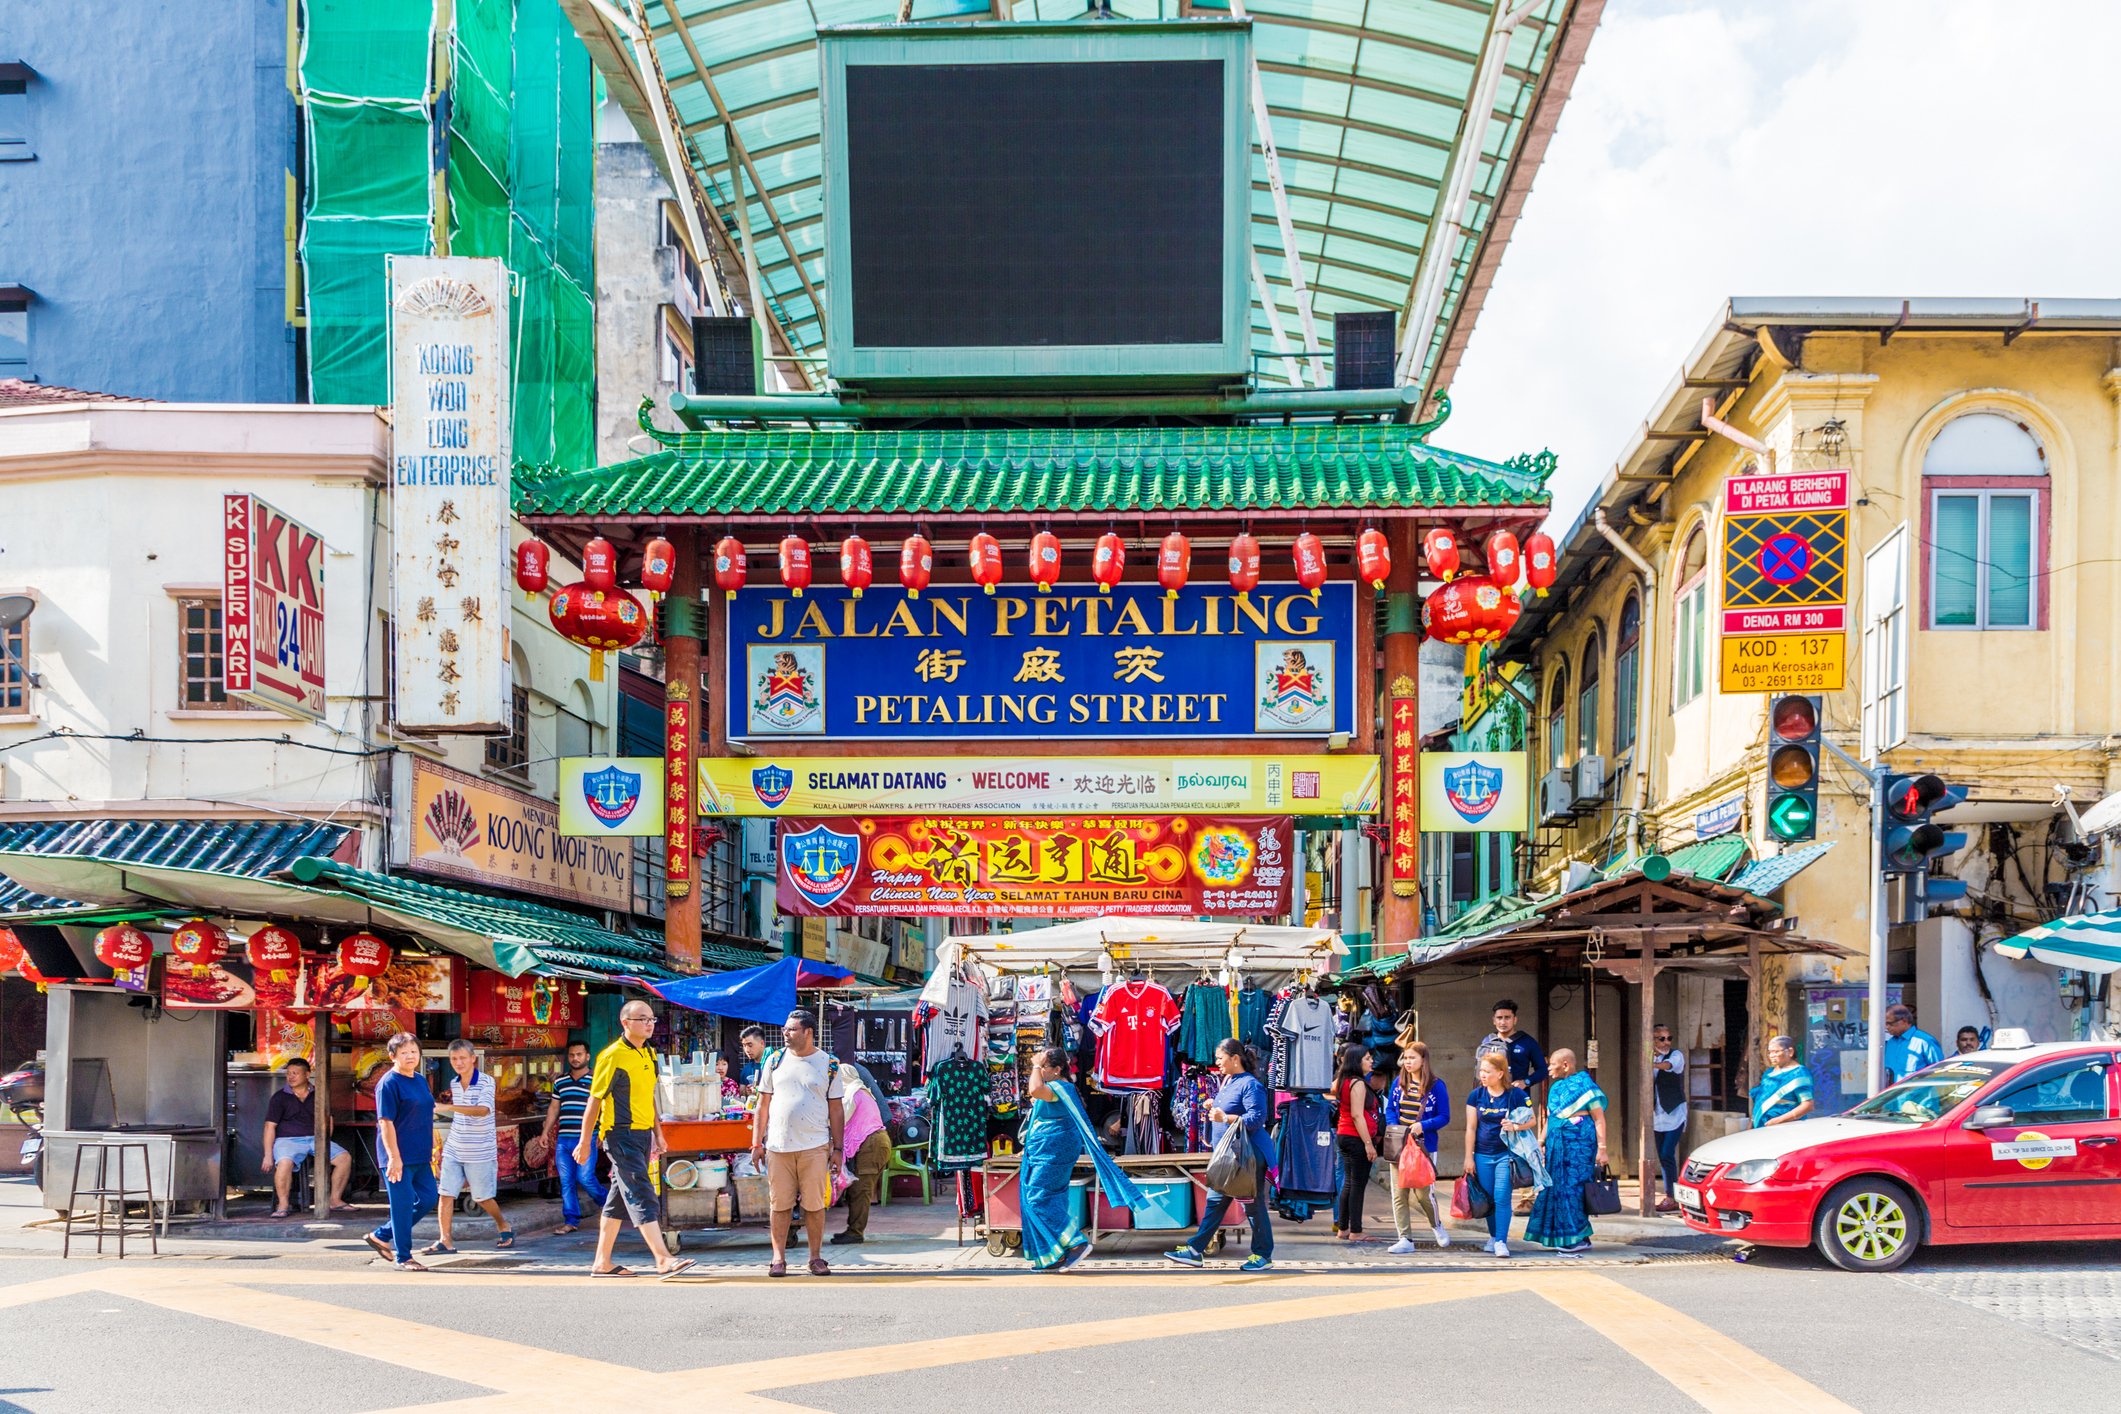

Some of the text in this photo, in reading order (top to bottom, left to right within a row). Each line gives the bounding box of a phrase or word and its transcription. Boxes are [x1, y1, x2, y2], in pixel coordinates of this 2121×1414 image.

[415, 343, 474, 375] KOONG
[426, 380, 466, 412] WOH
[423, 416, 468, 449] TONG
[397, 454, 497, 486] ENTERPRISE
[1733, 476, 1841, 495] DILARANG BERHENTI
[1741, 491, 1831, 508] DI PETAK KUNING
[227, 498, 245, 529] KK
[256, 503, 319, 610] KK
[228, 537, 247, 617] SUPER
[757, 594, 1324, 639] JALAN PETALING
[1743, 613, 1824, 628] DENDA RM 300
[255, 588, 324, 679] BUKA 24 JAM
[229, 624, 248, 688] MART
[1739, 640, 1777, 657] KOD
[1800, 639, 1829, 655] 137
[1732, 661, 1834, 674] Aduan Kerosakan
[1743, 676, 1756, 687] 03
[1766, 675, 1793, 687] 2691
[1797, 674, 1824, 686] 5128
[854, 693, 1227, 724] PETALING STREET
[808, 771, 880, 790] SELAMAT
[882, 771, 947, 790] DATANG
[971, 771, 1050, 789] WELCOME
[1073, 773, 1156, 795] 欢迎光临
[1267, 763, 1281, 806] 丙申年
[813, 802, 837, 810] KUALA
[838, 802, 868, 810] LUMPUR
[914, 802, 937, 810] PETTY
[1002, 820, 1065, 830] 新年快樂
[1082, 818, 1144, 829] 恭喜發財
[487, 812, 545, 860] KOONG
[552, 835, 586, 870] WOH
[592, 844, 625, 881] TONG
[750, 853, 762, 863] TEL
[804, 877, 841, 888] KUALA LUMPUR
[871, 869, 923, 886] Happy
[870, 886, 1183, 903] Chinese New Year SELAMAT TAHUN BARU CINA
[855, 905, 889, 913] PERSATUAN
[889, 905, 916, 913] PENJAJA
[916, 905, 928, 913] DAN
[928, 905, 954, 913] PENIAGA
[954, 905, 971, 913] KECIL
[1106, 905, 1124, 913] PETTY
[1153, 905, 1192, 913] ASSOCIATION
